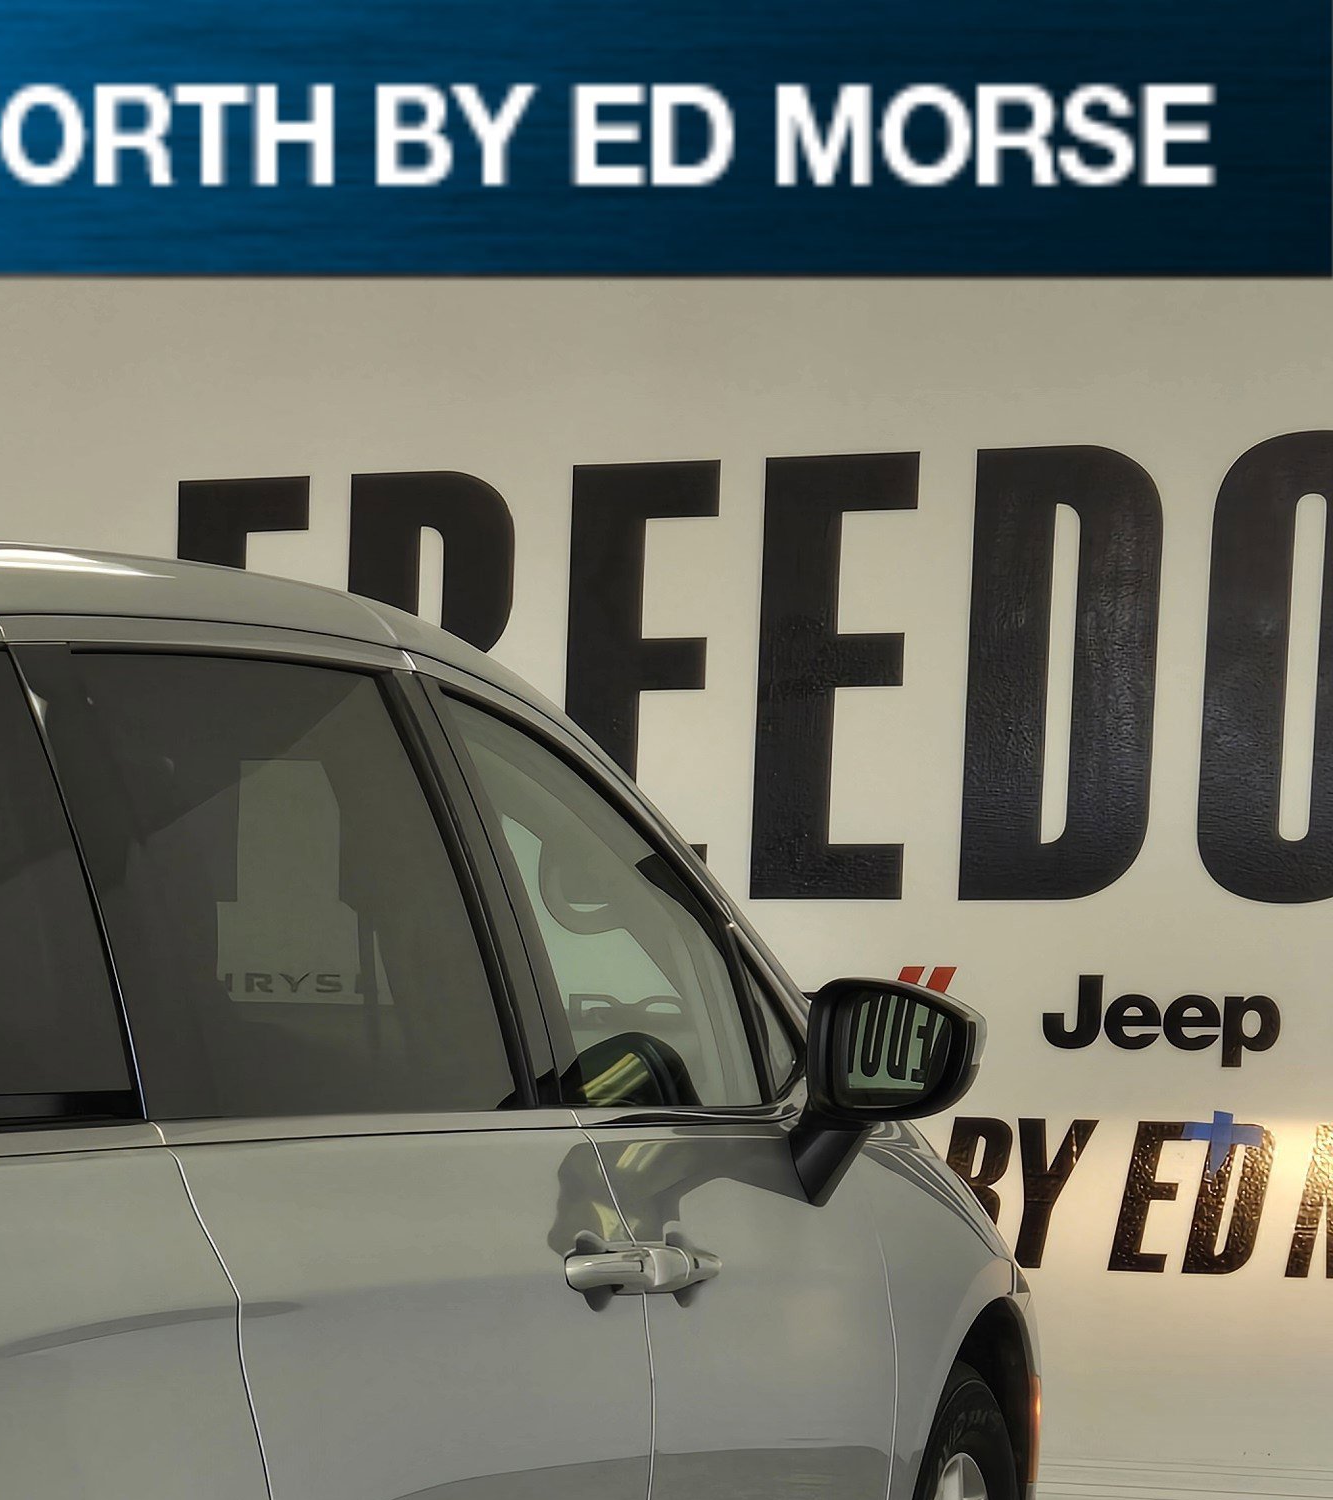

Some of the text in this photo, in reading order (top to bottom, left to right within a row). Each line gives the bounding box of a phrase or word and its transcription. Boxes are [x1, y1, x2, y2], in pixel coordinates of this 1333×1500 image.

[176, 428, 1333, 903] EEDO
[1042, 974, 1281, 1068] Jeep
[946, 1116, 1100, 1269] BY
[1107, 1120, 1277, 1275] ED
